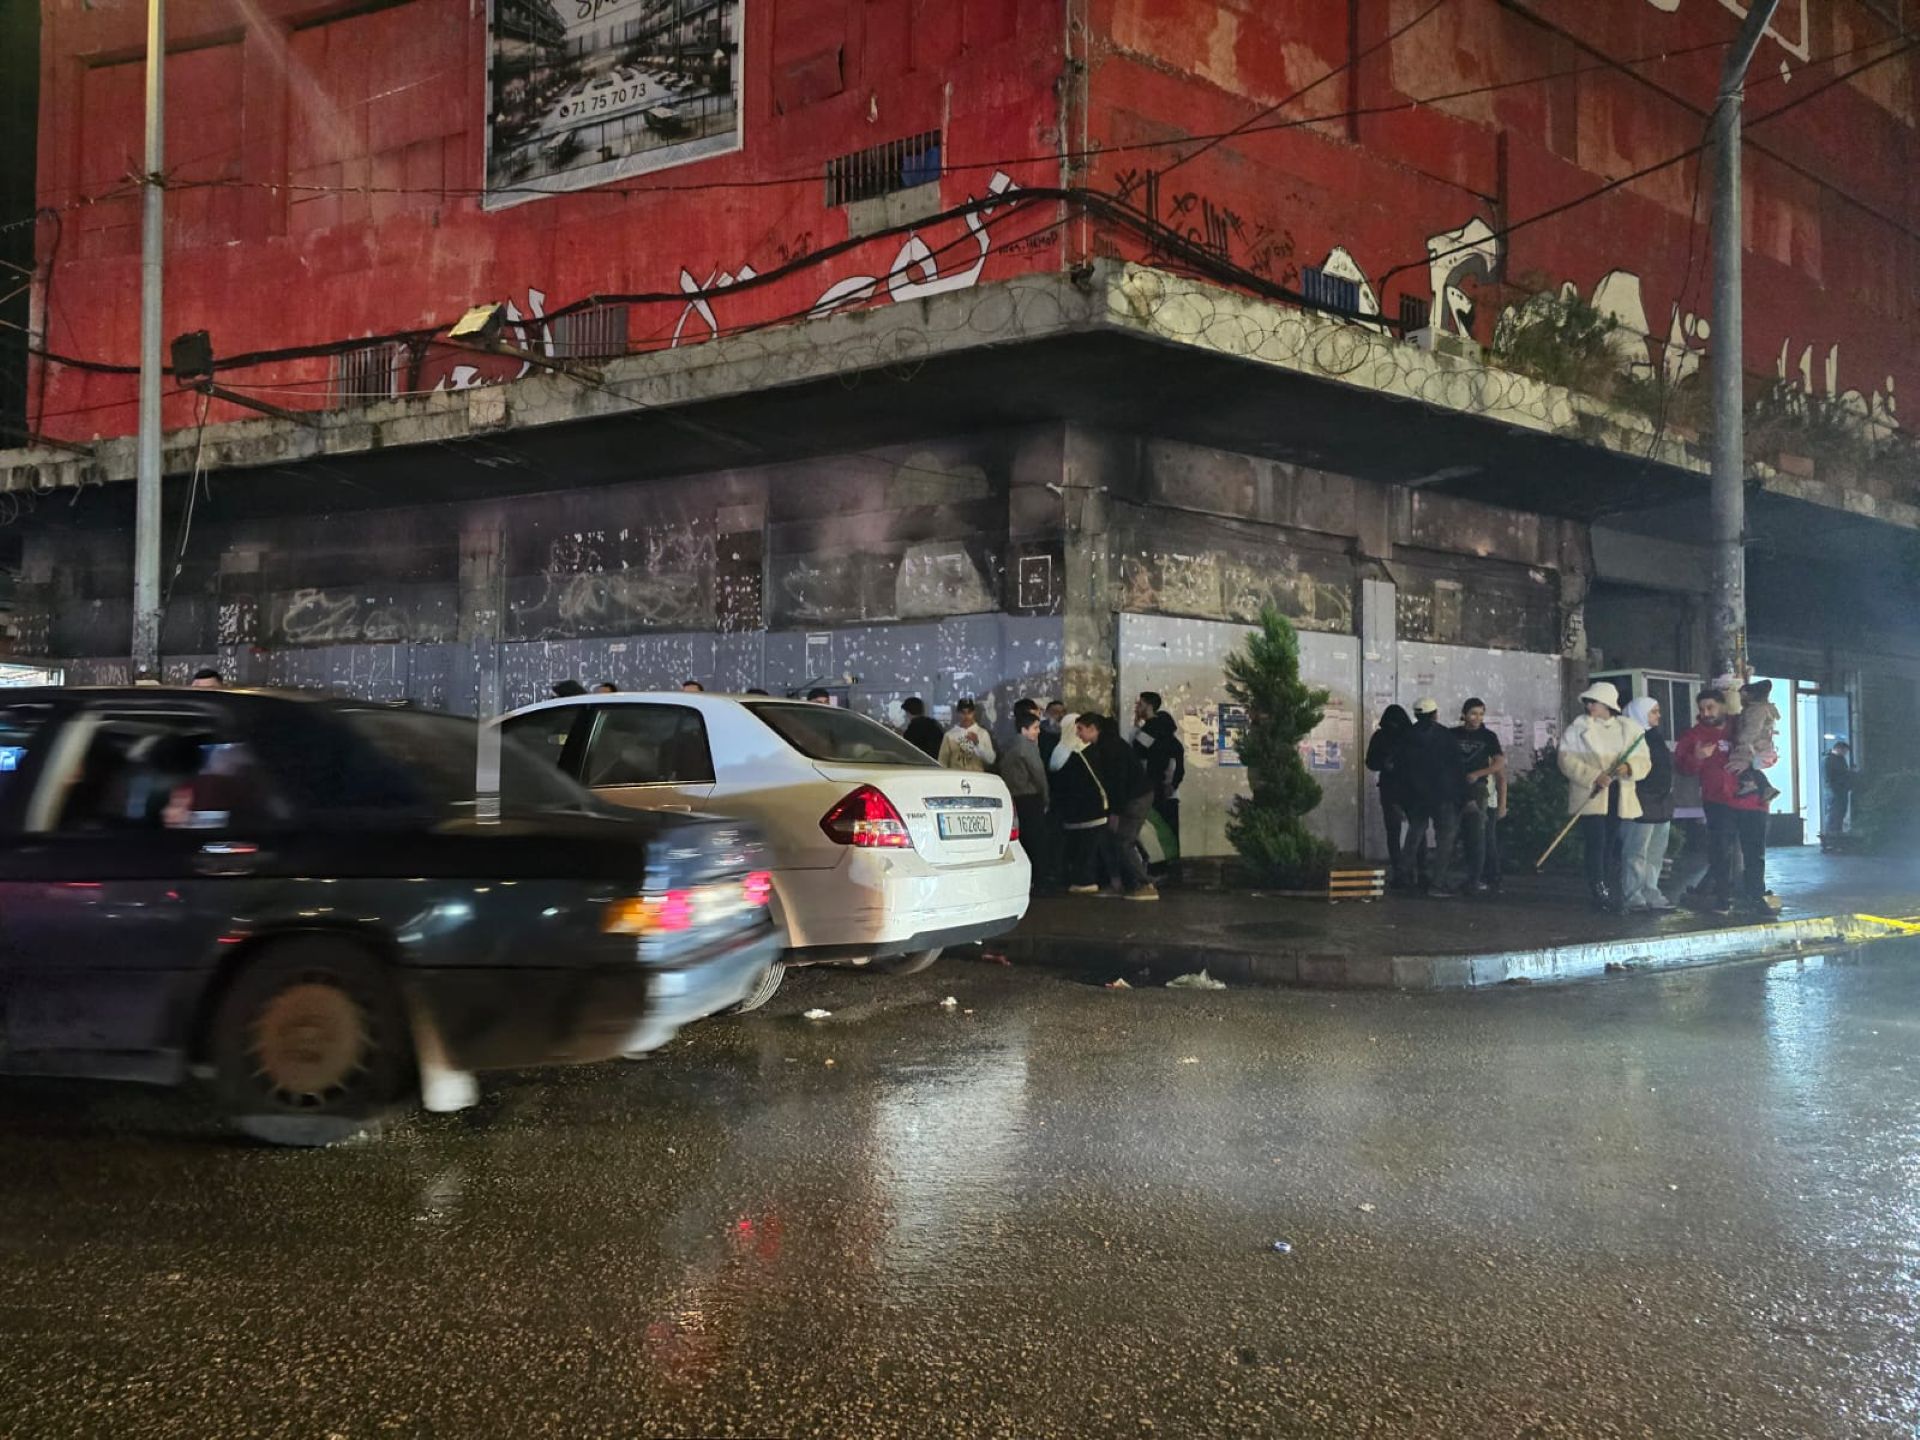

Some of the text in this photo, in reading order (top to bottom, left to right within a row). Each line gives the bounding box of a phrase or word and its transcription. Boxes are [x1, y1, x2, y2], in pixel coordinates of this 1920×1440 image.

[571, 82, 646, 116] 71 75 70 73
